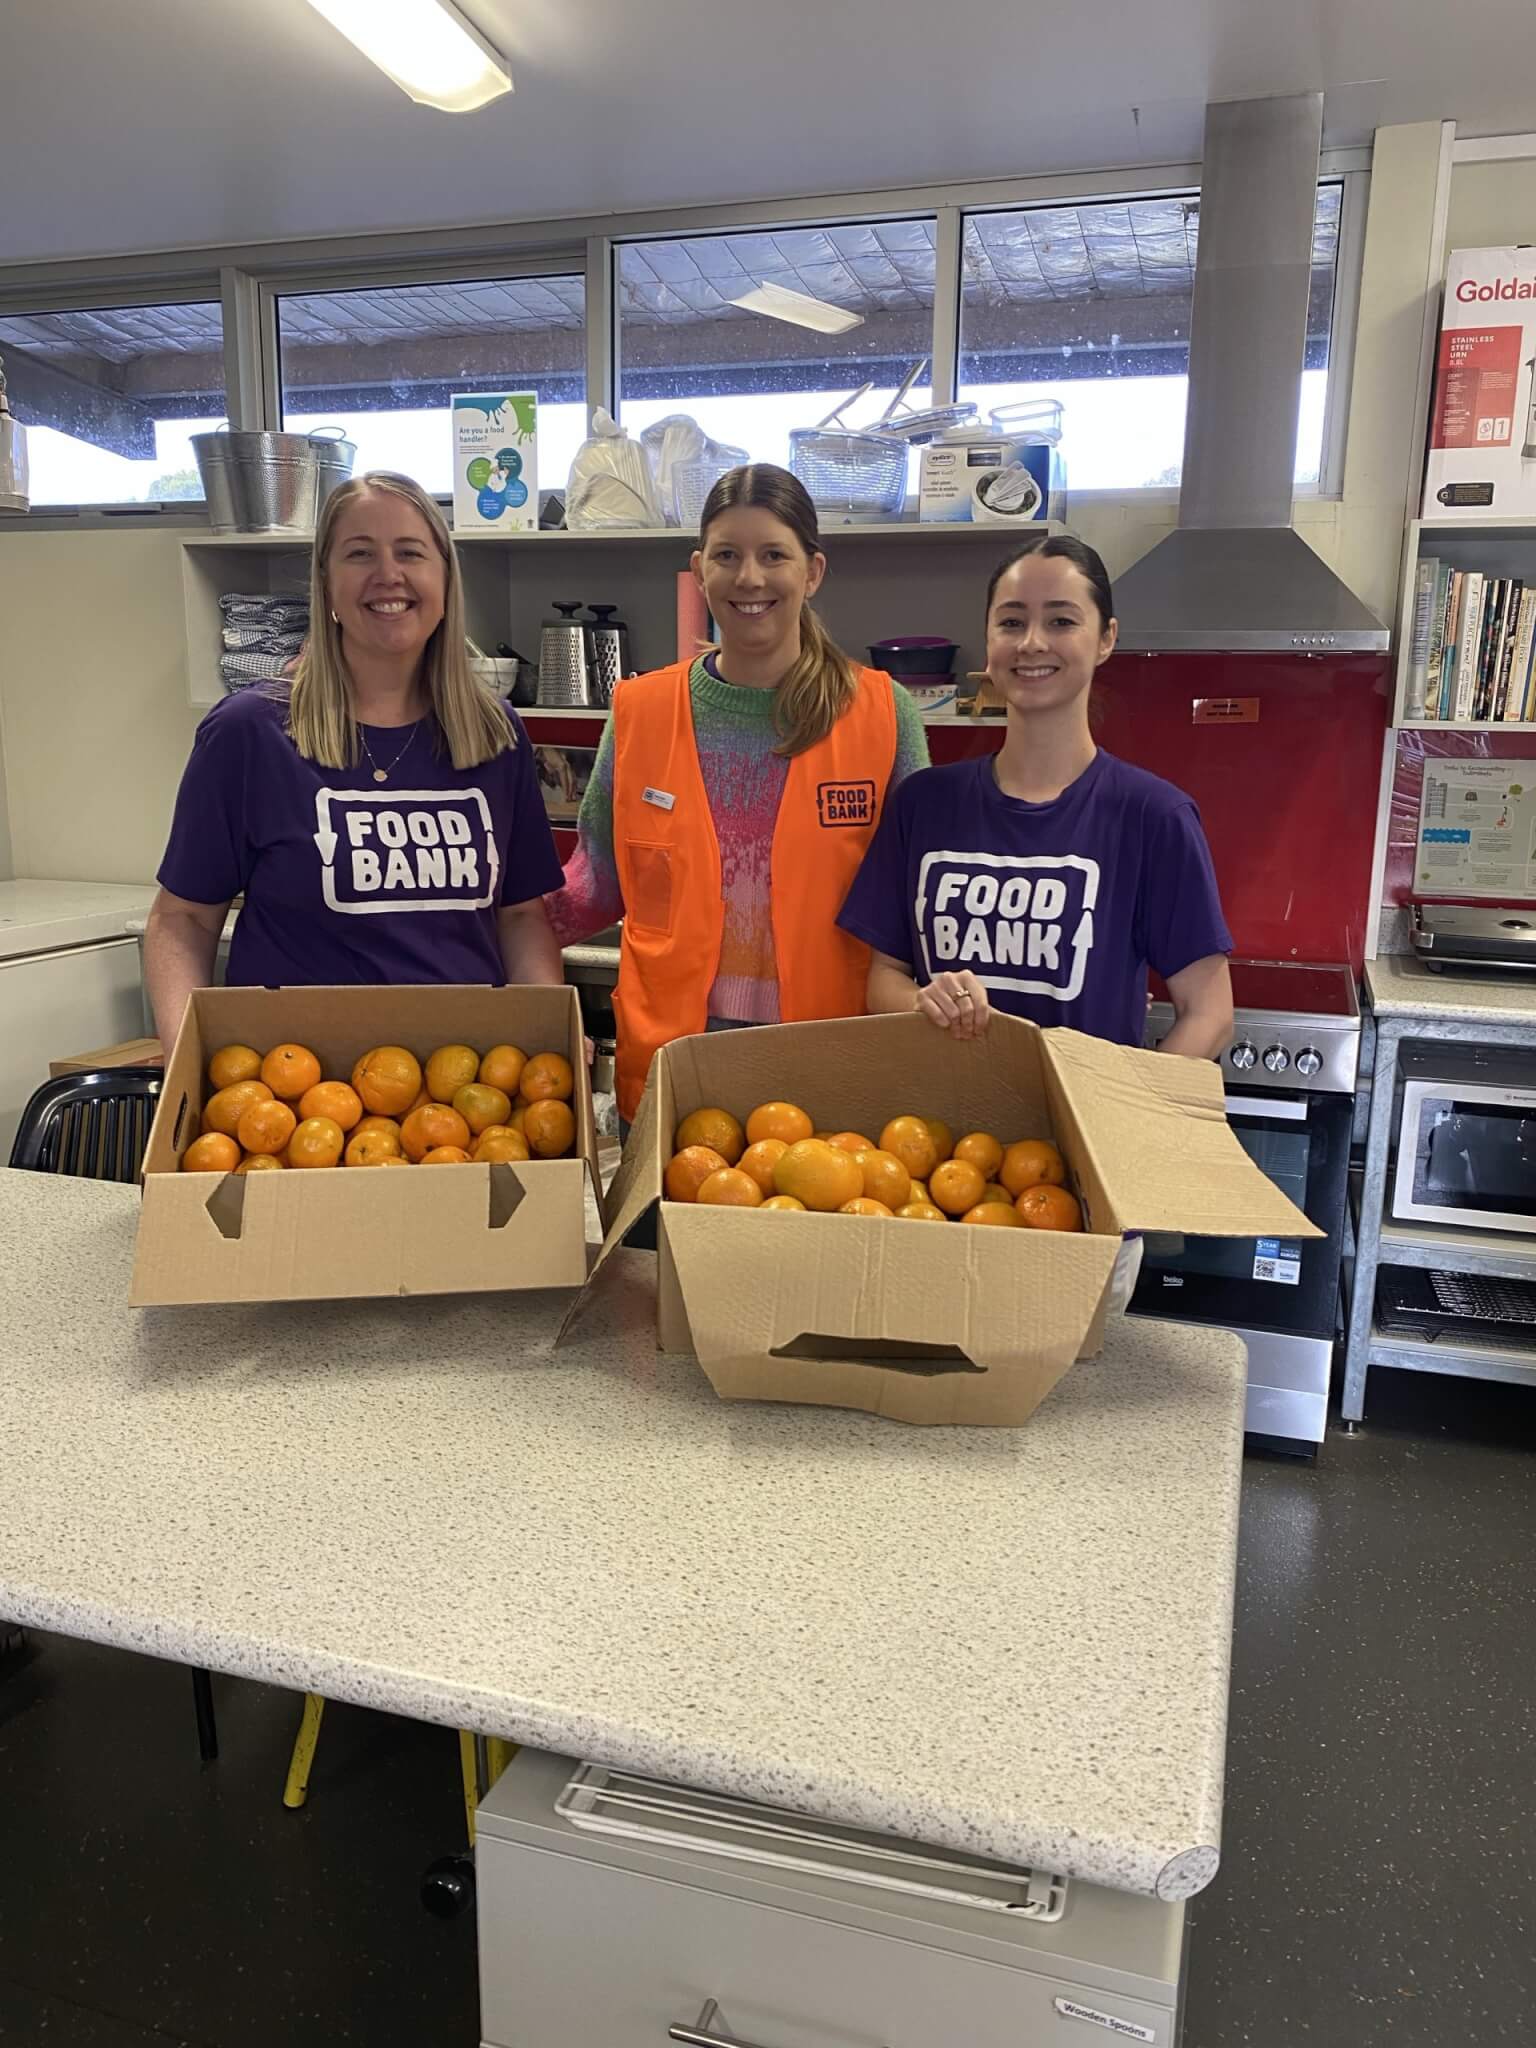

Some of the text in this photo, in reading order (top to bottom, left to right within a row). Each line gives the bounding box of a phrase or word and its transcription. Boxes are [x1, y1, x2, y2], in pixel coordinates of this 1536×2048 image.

[1451, 335, 1495, 344] STAINLESS
[1449, 351, 1468, 359] URN
[1450, 344, 1474, 352] STEEL
[459, 426, 470, 434] Are
[471, 427, 483, 435] you
[489, 426, 505, 434] food
[459, 434, 488, 442] handler?
[1440, 491, 1449, 499] G
[827, 789, 867, 804] FOOD
[828, 804, 868, 819] BANK
[345, 810, 472, 848] FOOD
[351, 848, 479, 891] BANK
[935, 873, 1067, 920] FOOD
[933, 916, 1062, 970] BANK
[1063, 2003, 1147, 2038] Wooden Spoons
